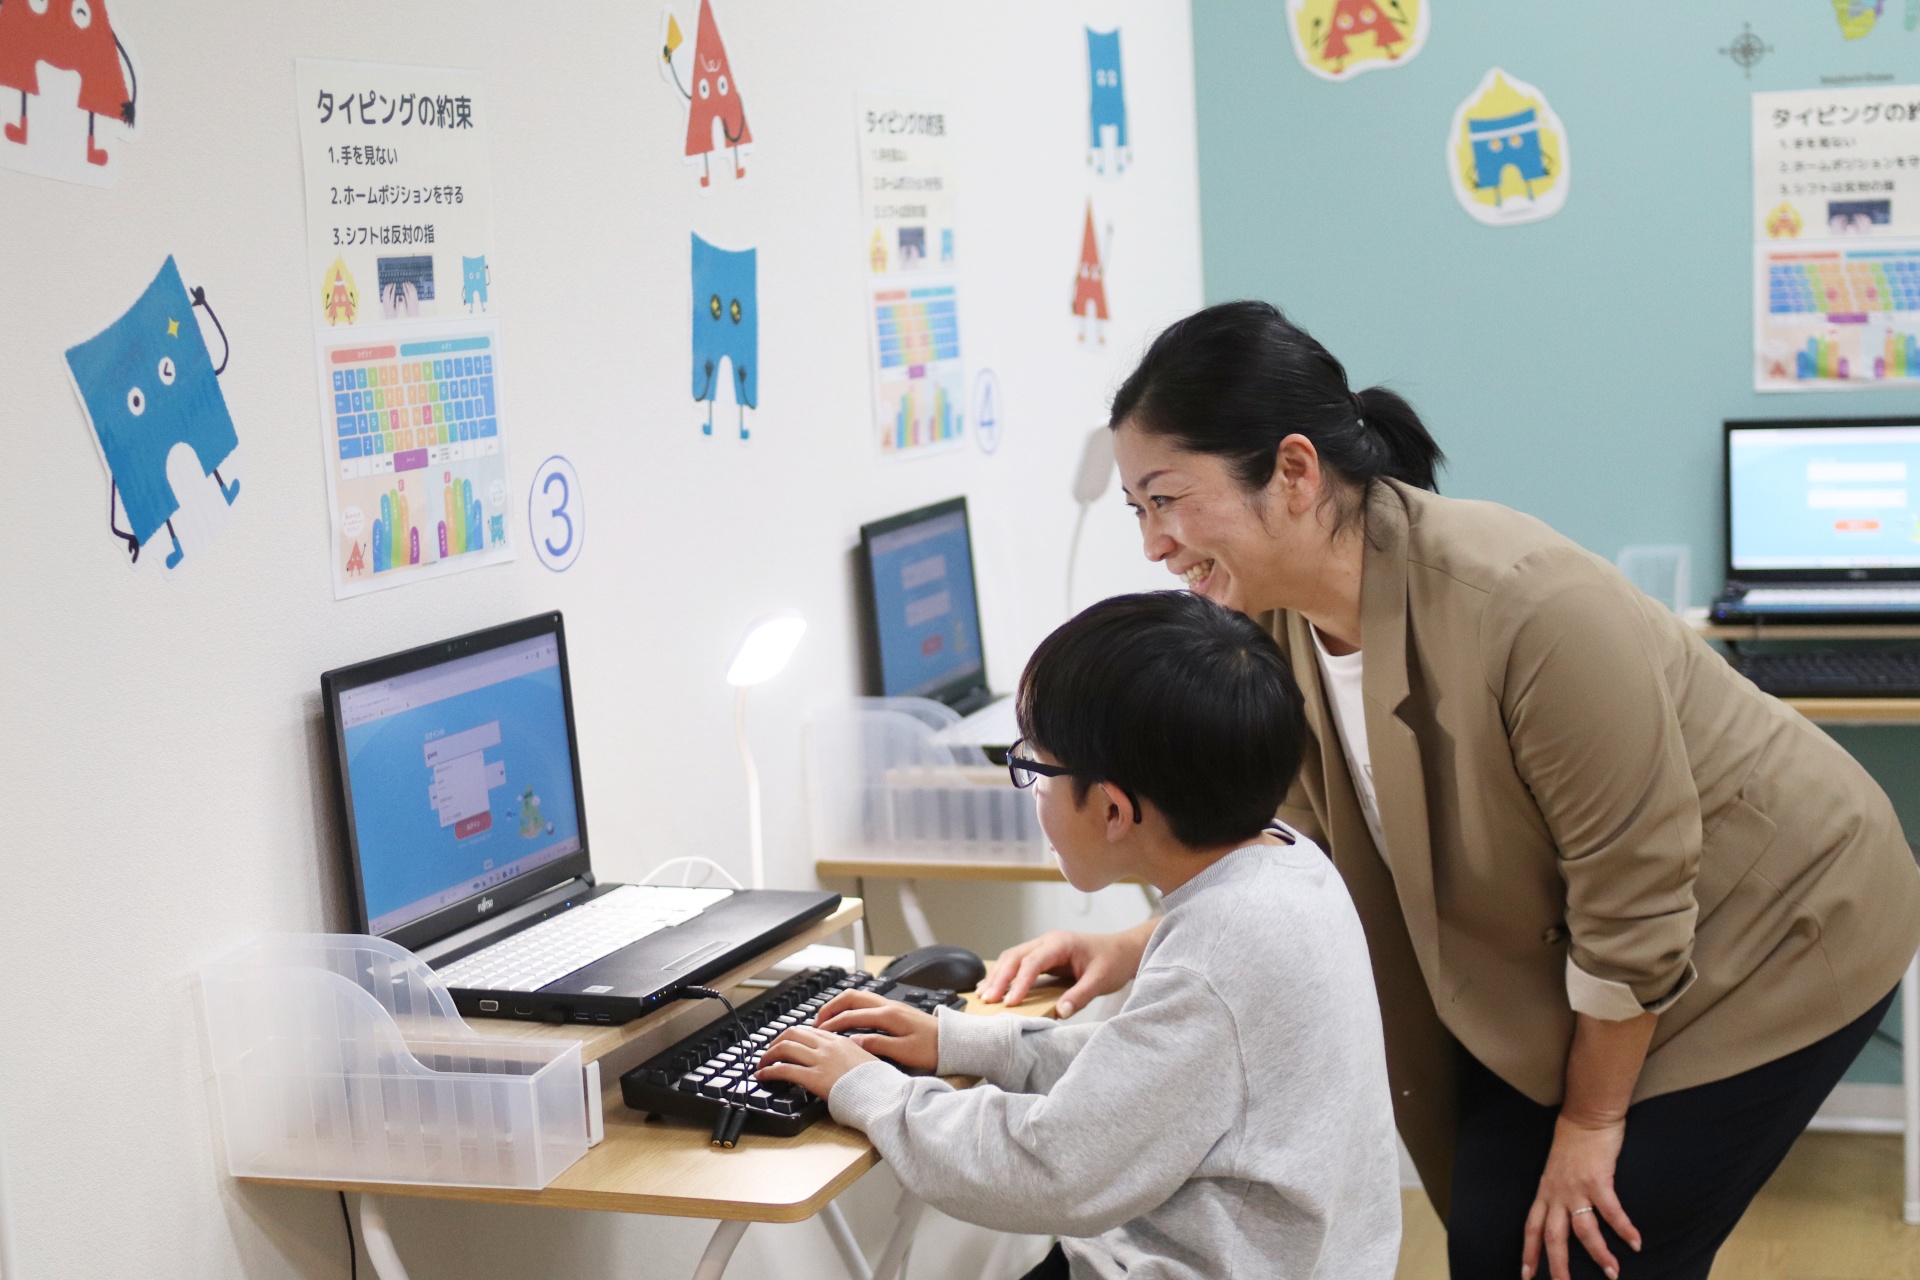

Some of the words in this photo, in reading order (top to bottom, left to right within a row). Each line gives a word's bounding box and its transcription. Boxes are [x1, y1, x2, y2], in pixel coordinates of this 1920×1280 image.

[317, 89, 473, 129] タイピングの約束
[328, 145, 398, 165] 1.手を見ない
[331, 184, 464, 205] 2.ホームポジションを守る
[333, 224, 435, 245] 3.シフトは反対の指
[543, 471, 573, 557] 3
